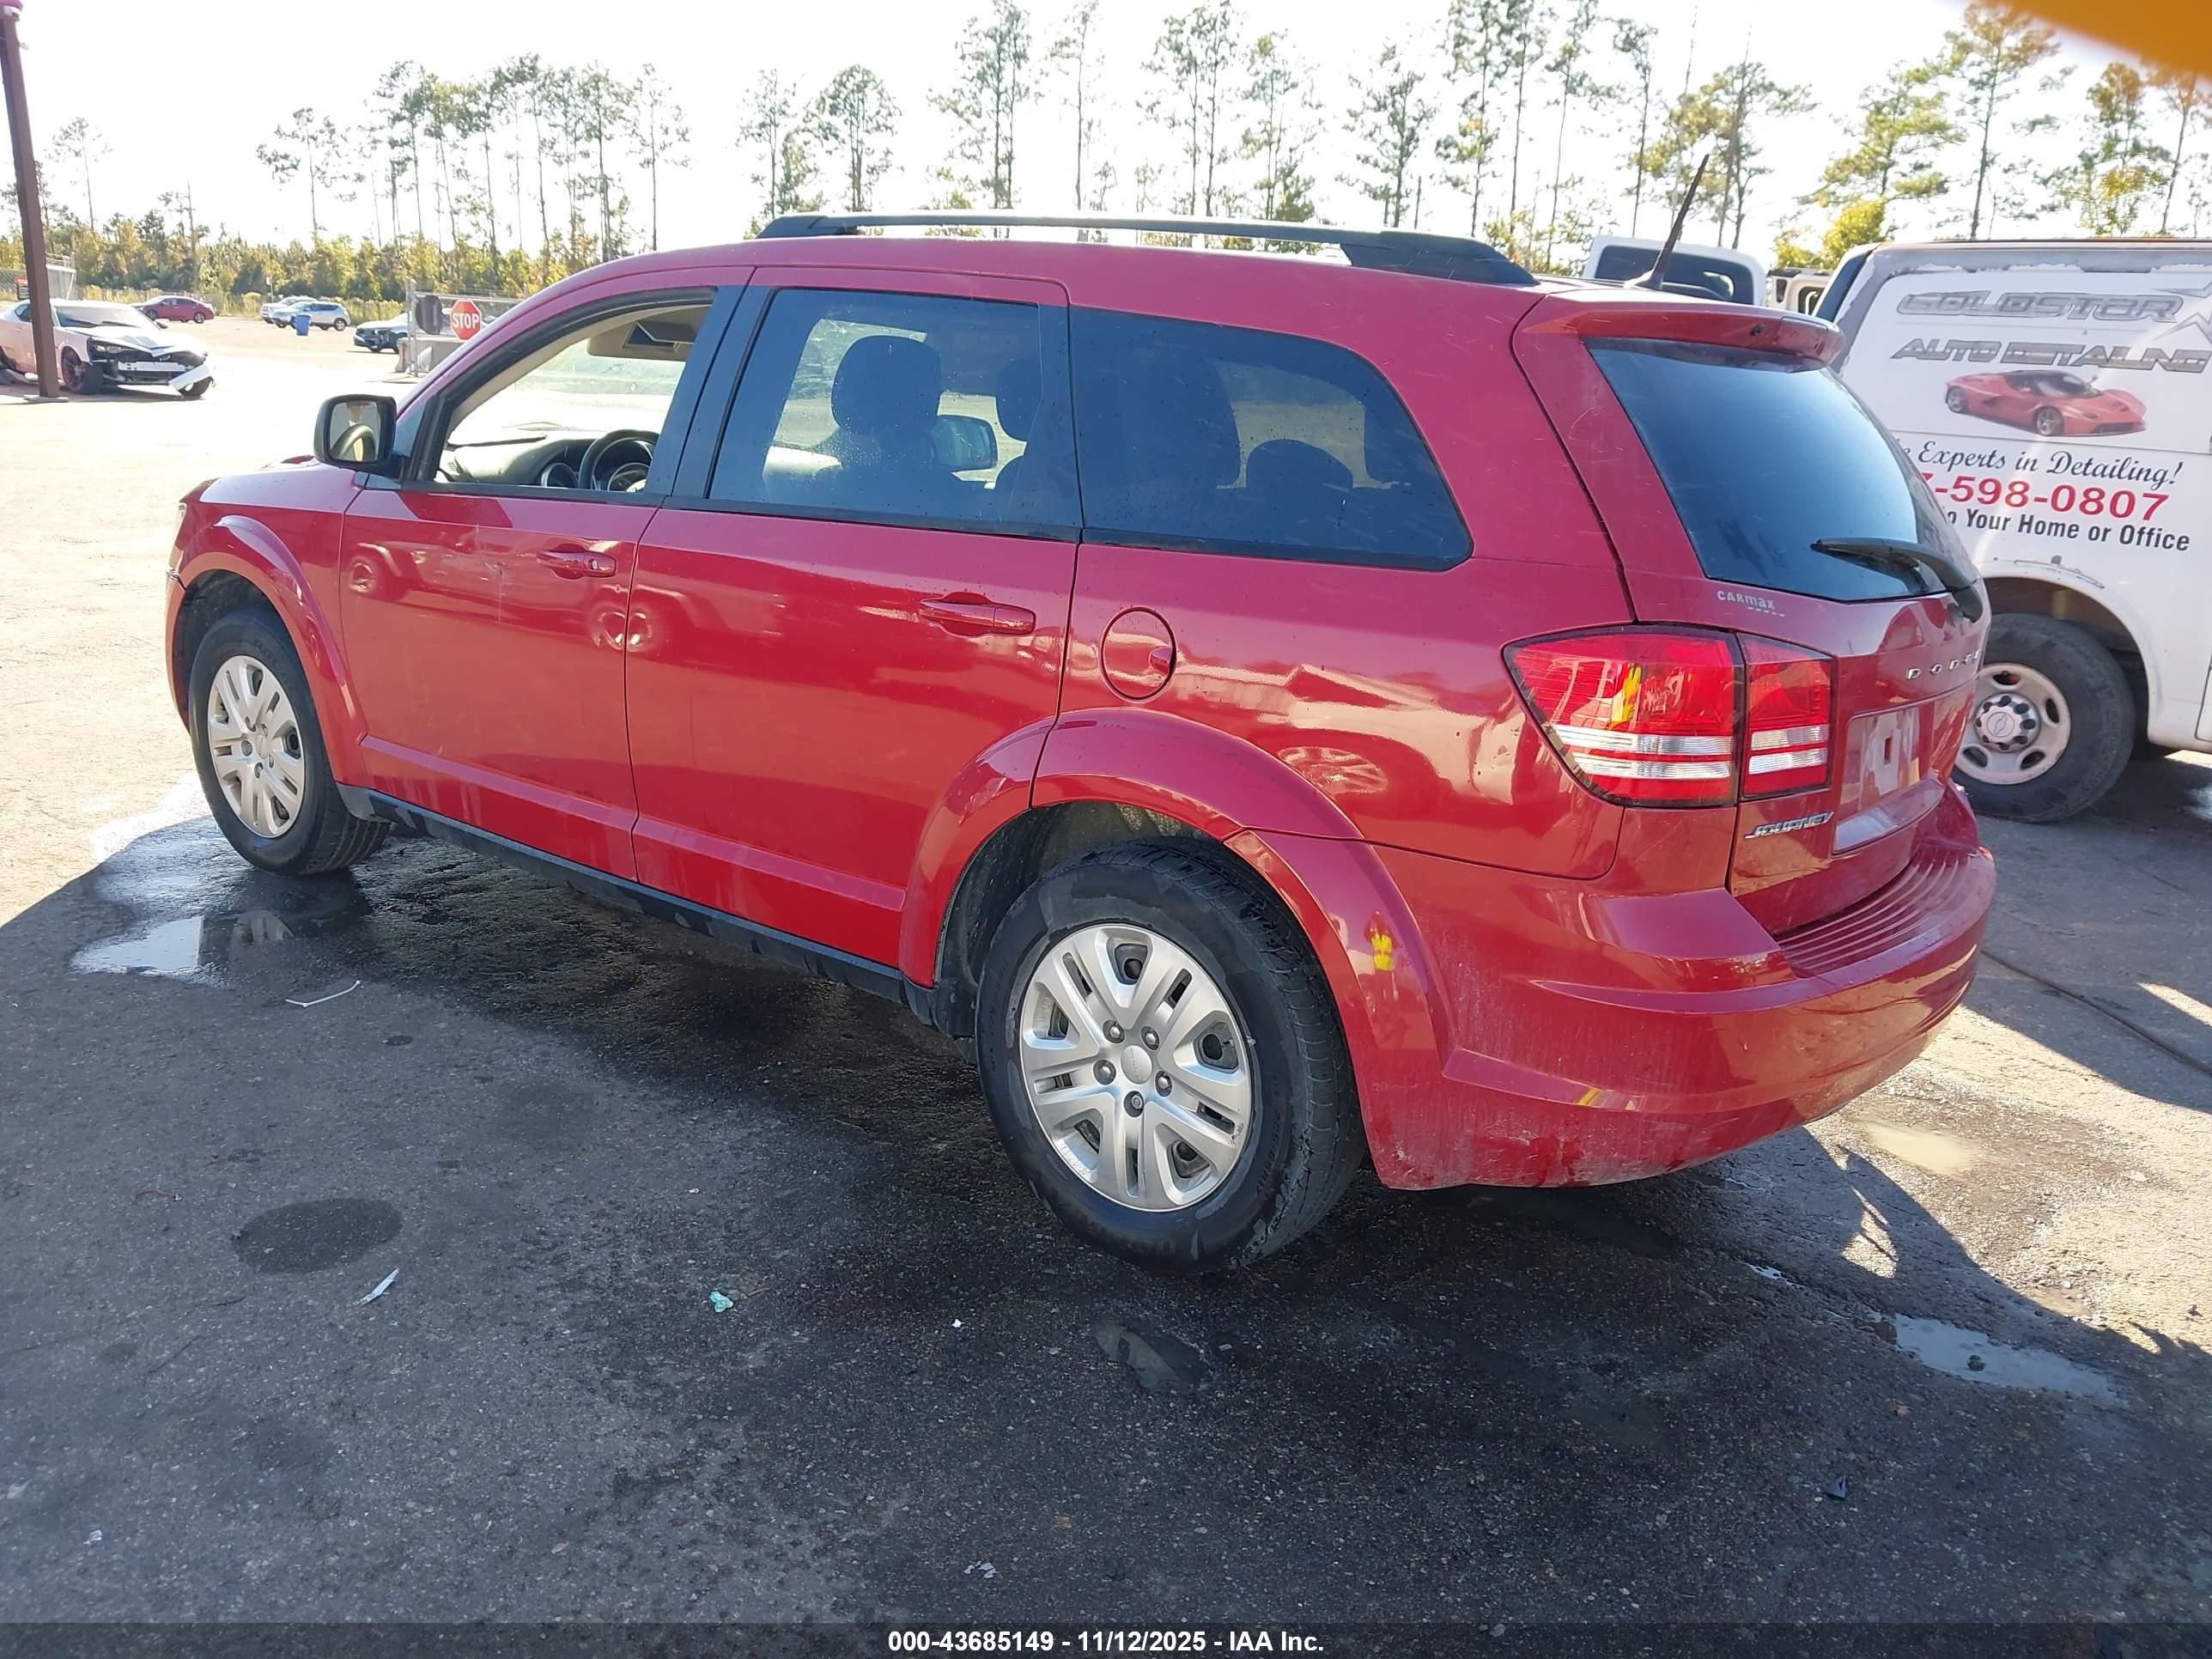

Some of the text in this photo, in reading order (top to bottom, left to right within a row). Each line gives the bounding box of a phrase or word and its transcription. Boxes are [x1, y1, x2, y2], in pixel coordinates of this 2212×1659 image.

[453, 313, 479, 329] STOP
[1890, 337, 2212, 374] AUTO DETAILING
[1917, 441, 2006, 471] Experts
[2015, 452, 2039, 471] in
[2046, 451, 2184, 490] Detailing!
[1966, 508, 2011, 531] Your
[2018, 514, 2079, 539] Home
[2088, 526, 2111, 543] or
[2119, 525, 2190, 551] Office
[1745, 811, 1834, 839] JOURNEY
